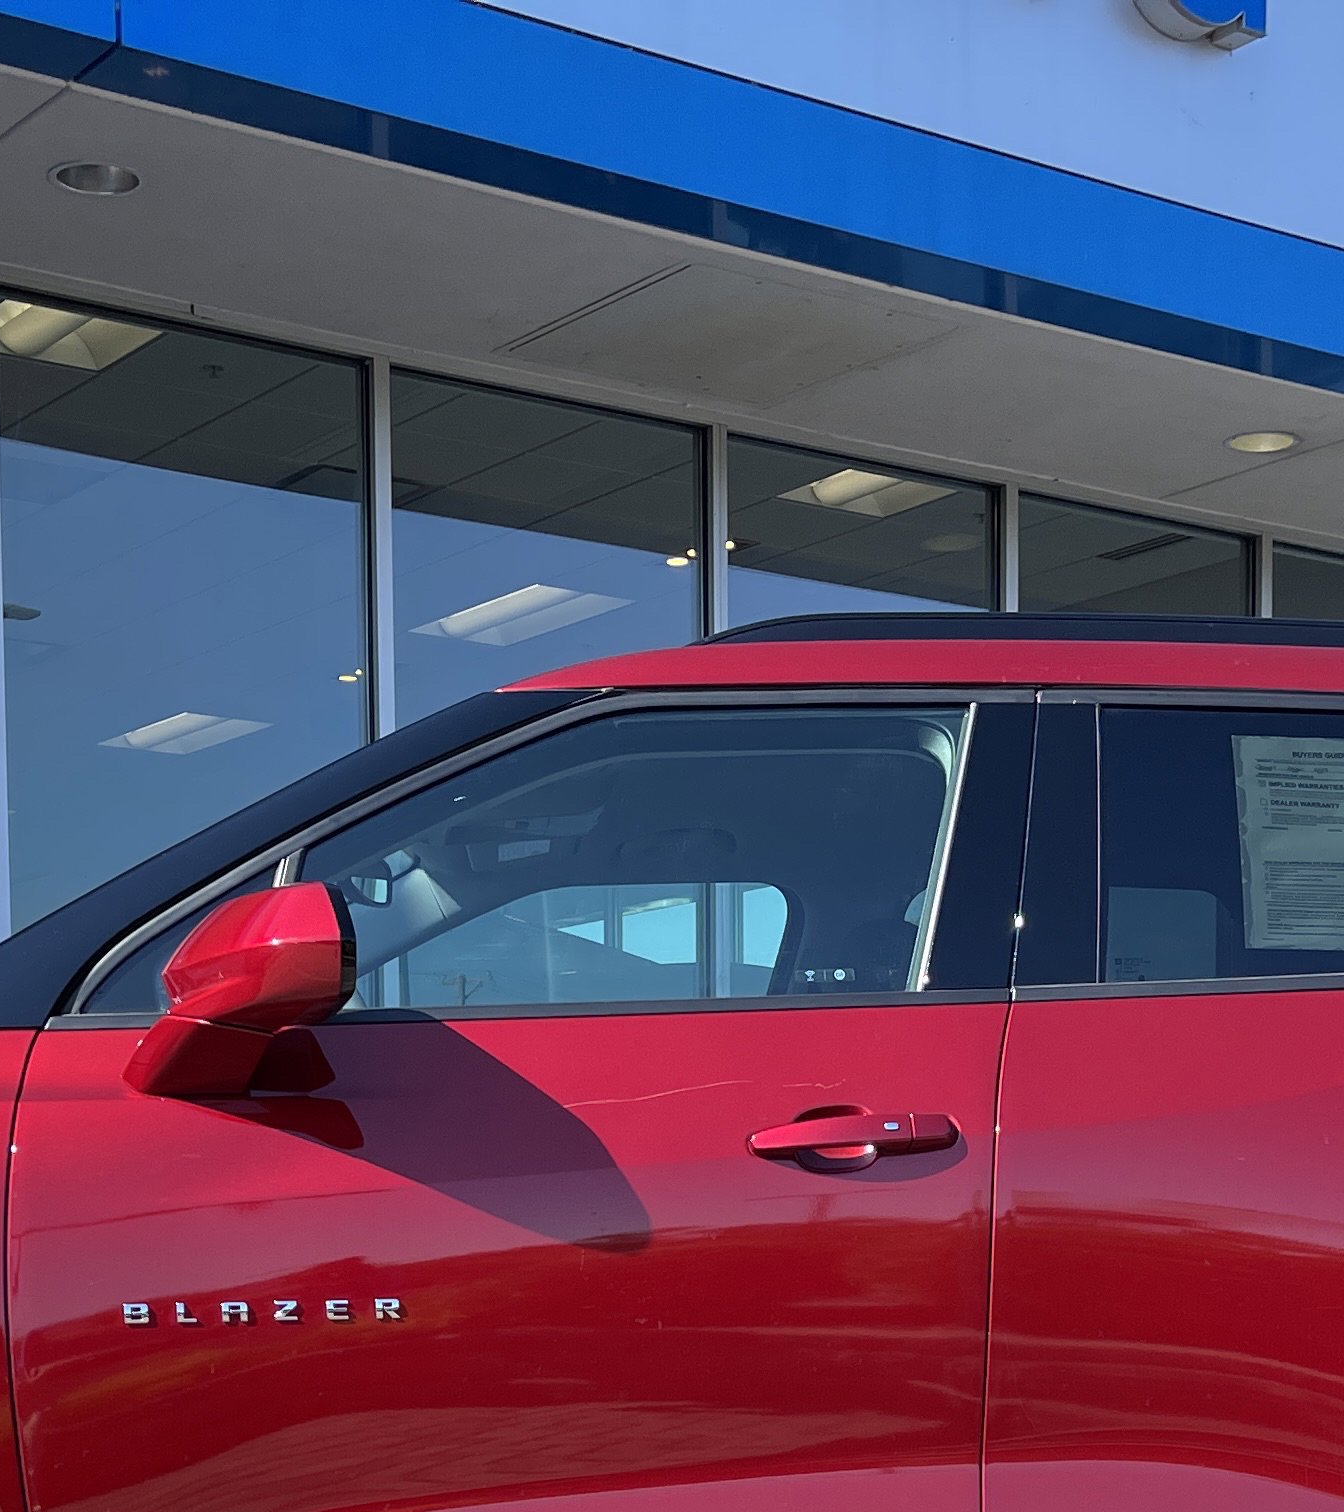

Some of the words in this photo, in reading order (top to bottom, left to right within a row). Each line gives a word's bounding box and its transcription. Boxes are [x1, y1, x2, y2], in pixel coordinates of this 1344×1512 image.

[1292, 751, 1323, 759] BUYERS
[1268, 781, 1296, 789] IMPLIED
[1298, 782, 1344, 791] WARRANTIES
[1270, 800, 1298, 808] DEALER
[1300, 801, 1340, 809] WARRANTY
[122, 1298, 401, 1324] BLAZER
